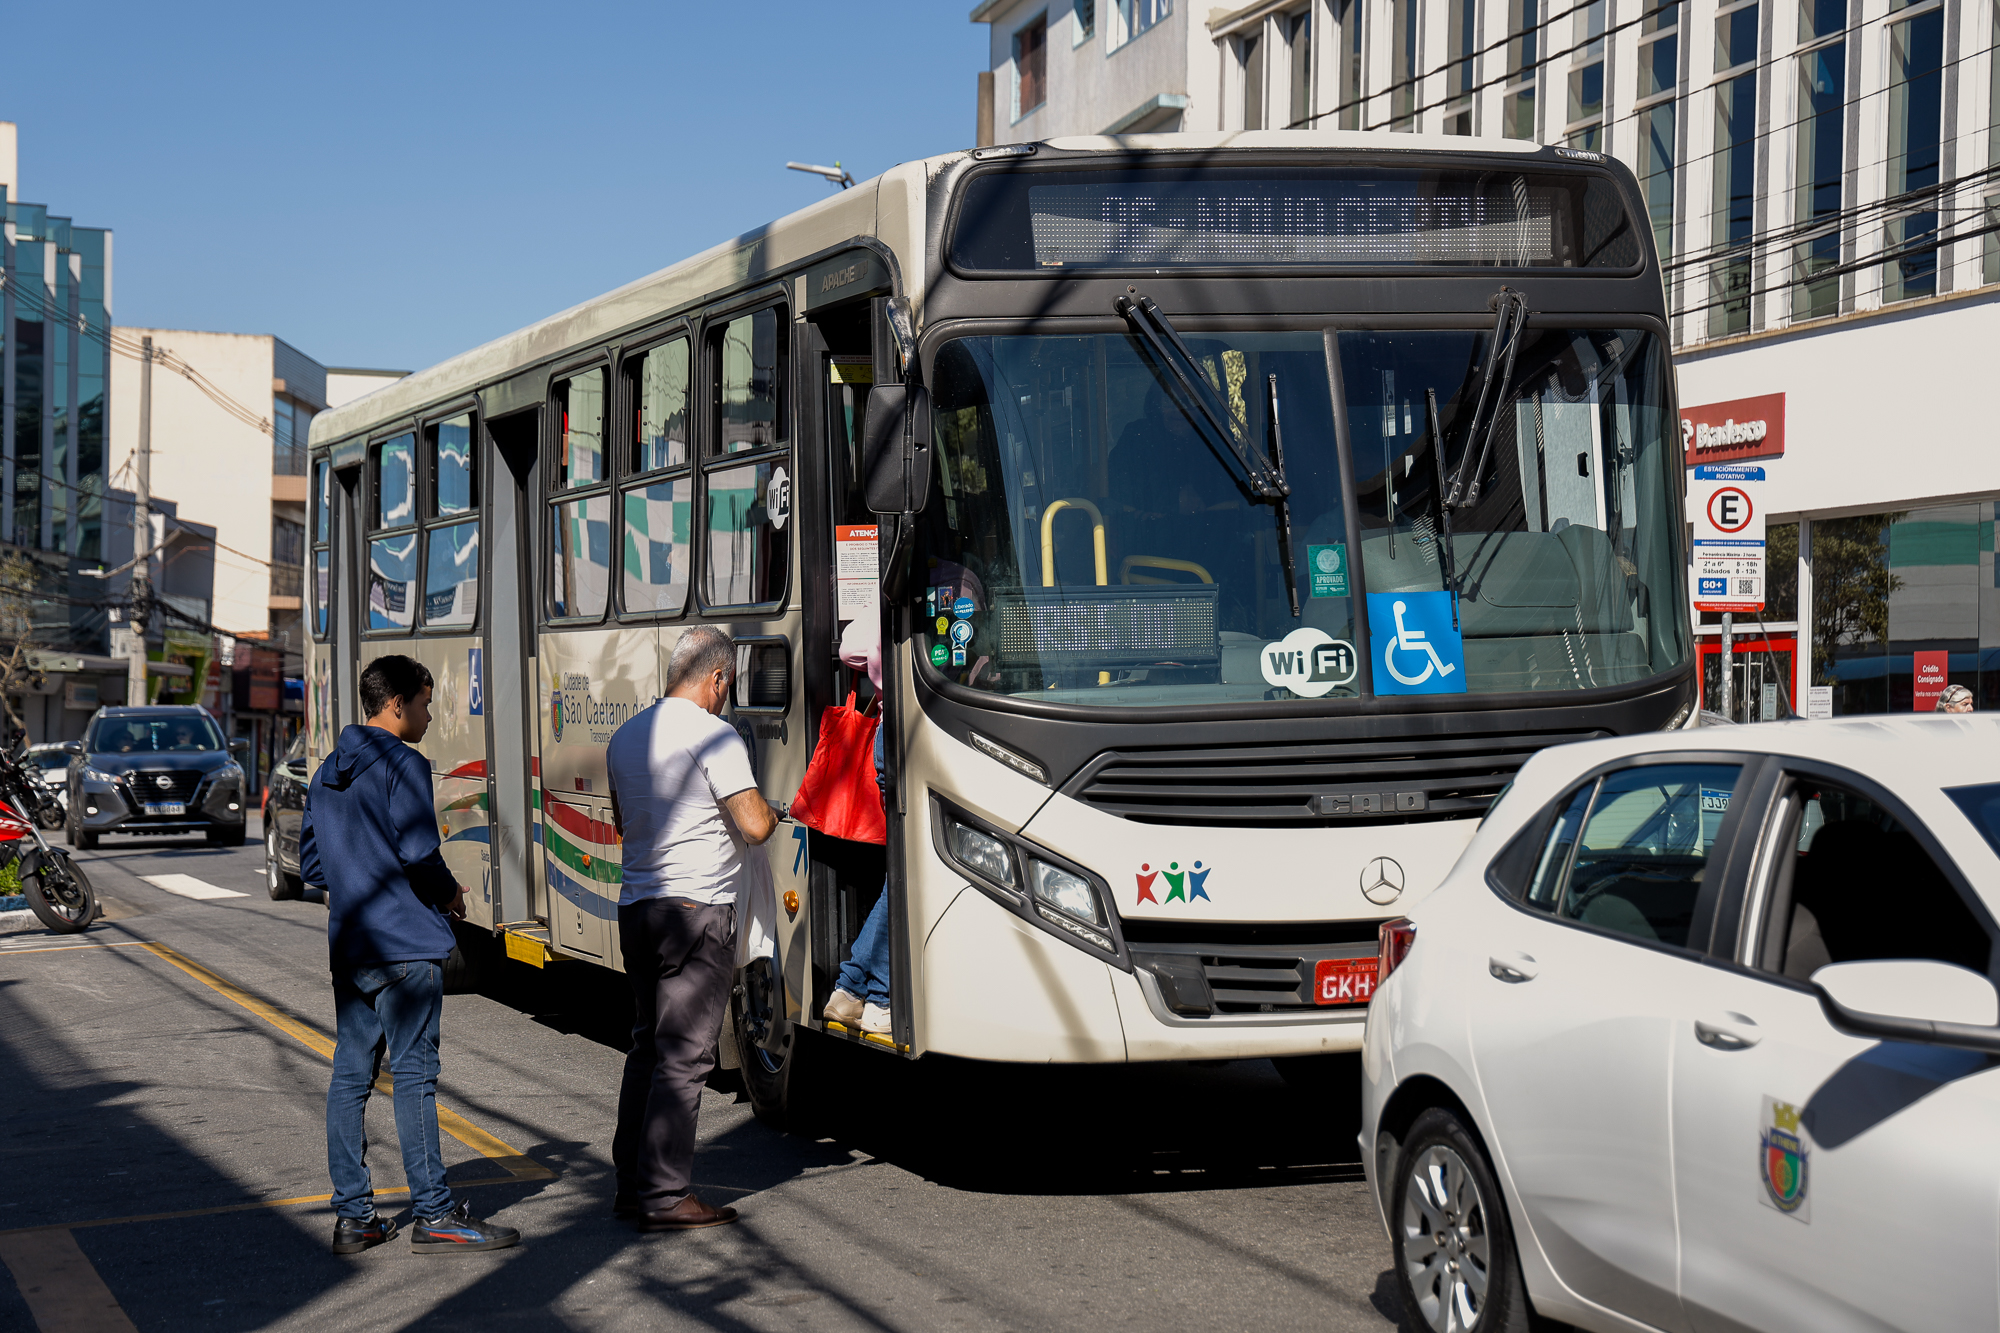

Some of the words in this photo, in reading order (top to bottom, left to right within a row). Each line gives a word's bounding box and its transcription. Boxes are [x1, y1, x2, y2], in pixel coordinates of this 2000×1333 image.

[1197, 196, 1324, 254] NOVA
[1336, 195, 1485, 253] GERTY
[821, 265, 856, 293] APACHE
[1695, 418, 1767, 449] Bradesco
[1703, 465, 1758, 473] ESTACIONAMENTO
[1720, 495, 1739, 525] E
[849, 528, 878, 539] ATENÇÃ
[1316, 575, 1344, 584] APROVADO
[1702, 580, 1723, 589] 60+
[1922, 664, 1939, 674] Crédito
[563, 671, 582, 691] Cidade
[582, 671, 590, 691] de
[1917, 674, 1944, 685] Consignado
[1931, 690, 1943, 698] consul
[564, 694, 582, 725] São
[585, 694, 628, 726] Caetano
[632, 694, 645, 717] d
[1320, 791, 1425, 815] CAIO
